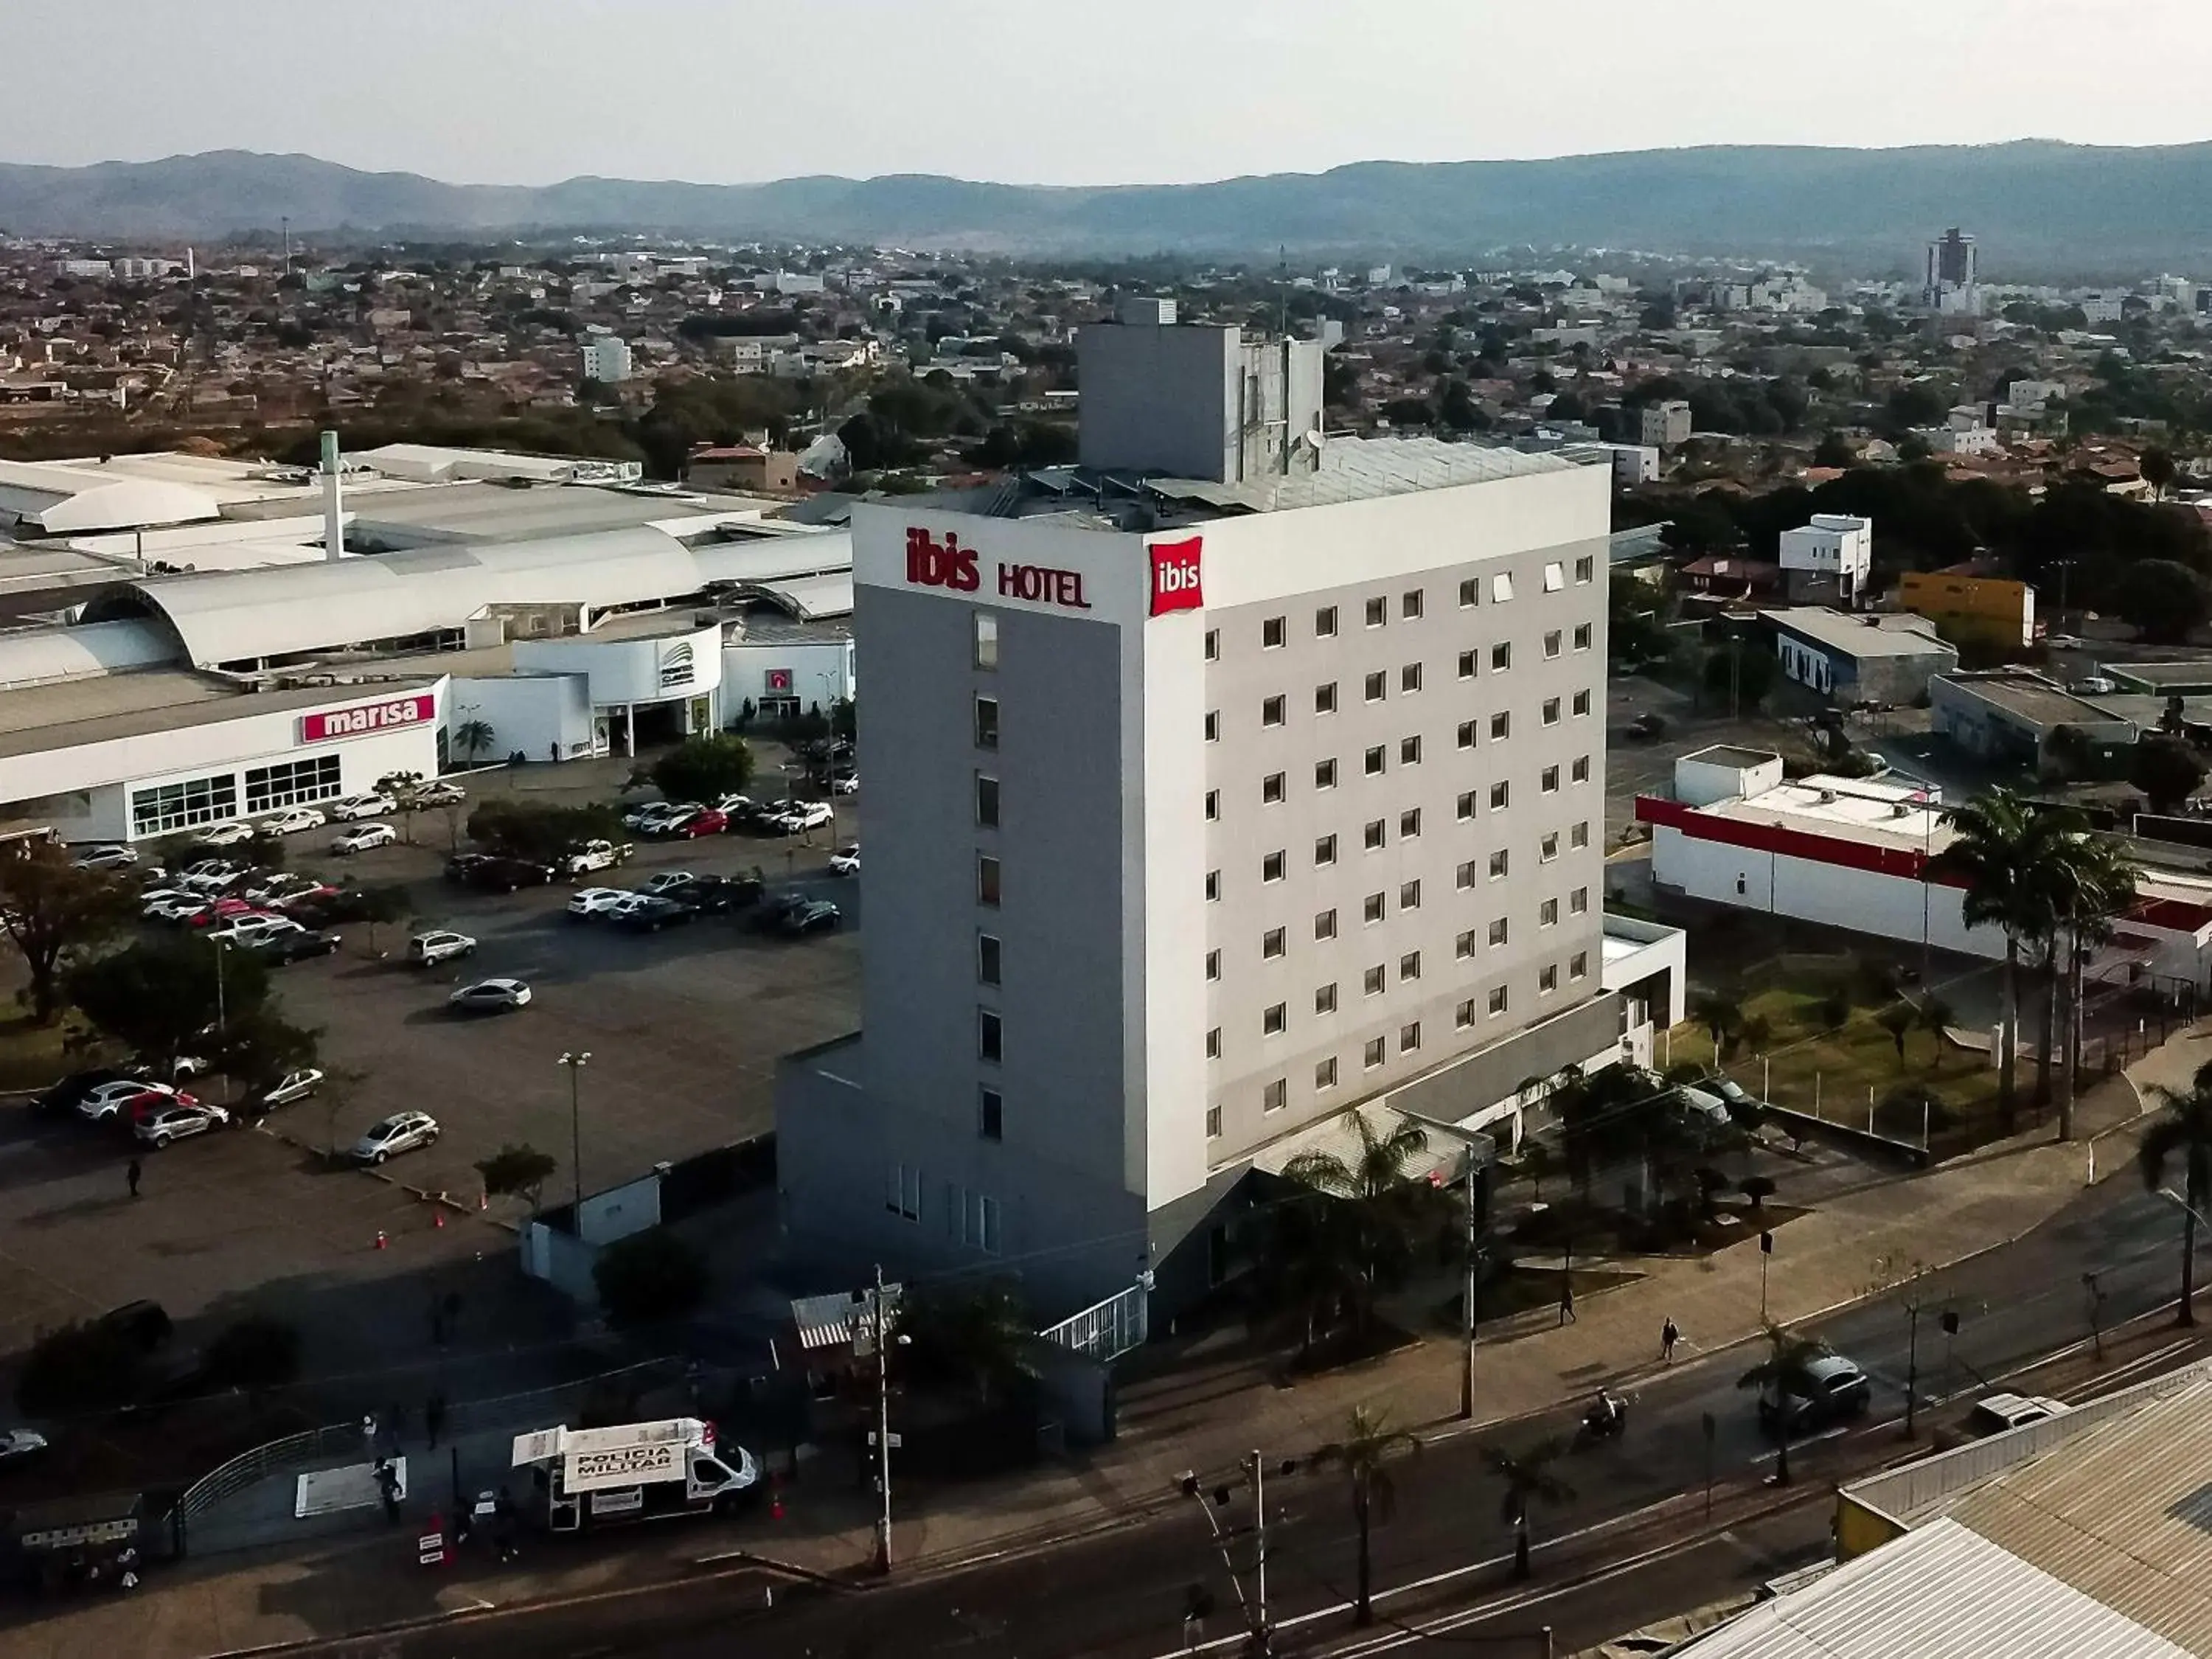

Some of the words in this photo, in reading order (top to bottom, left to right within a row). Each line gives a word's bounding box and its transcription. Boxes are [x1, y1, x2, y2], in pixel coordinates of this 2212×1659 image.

[906, 526, 980, 592] ibis
[998, 563, 1092, 608] HOTEL
[1160, 559, 1198, 593] ibis
[324, 700, 418, 734] marisa
[578, 1456, 670, 1474] MILITAR
